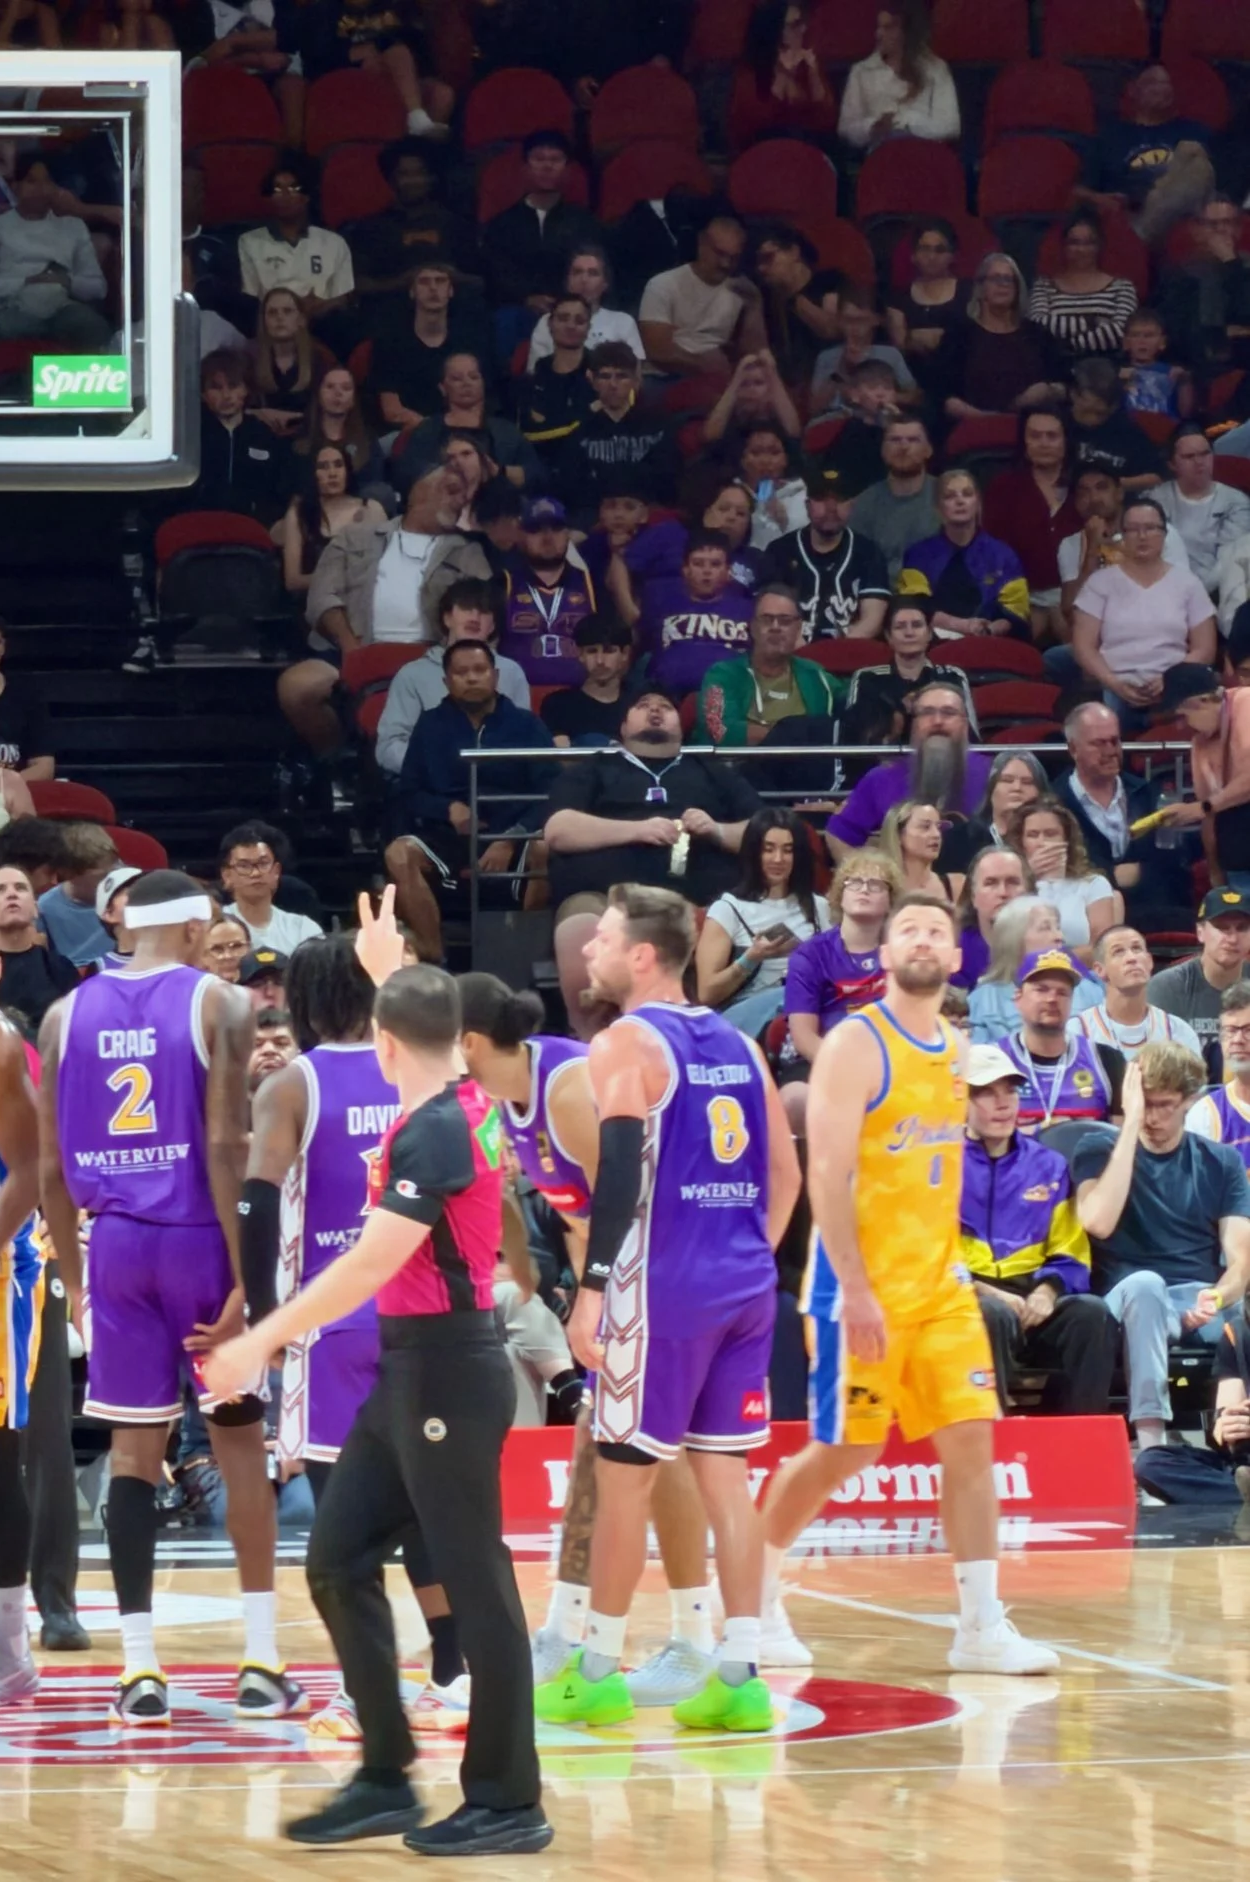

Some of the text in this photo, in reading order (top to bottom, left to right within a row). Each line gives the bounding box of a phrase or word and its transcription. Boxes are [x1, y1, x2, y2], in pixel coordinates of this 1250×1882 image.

[310, 255, 322, 275] 6
[34, 363, 128, 400] Sprite
[662, 613, 748, 648] KINGS
[106, 1062, 158, 1136] 2
[347, 1104, 404, 1136] DAVI
[706, 1095, 750, 1164] 8
[74, 1143, 190, 1168] WATERVIEW
[780, 1456, 1033, 1503] ormn
